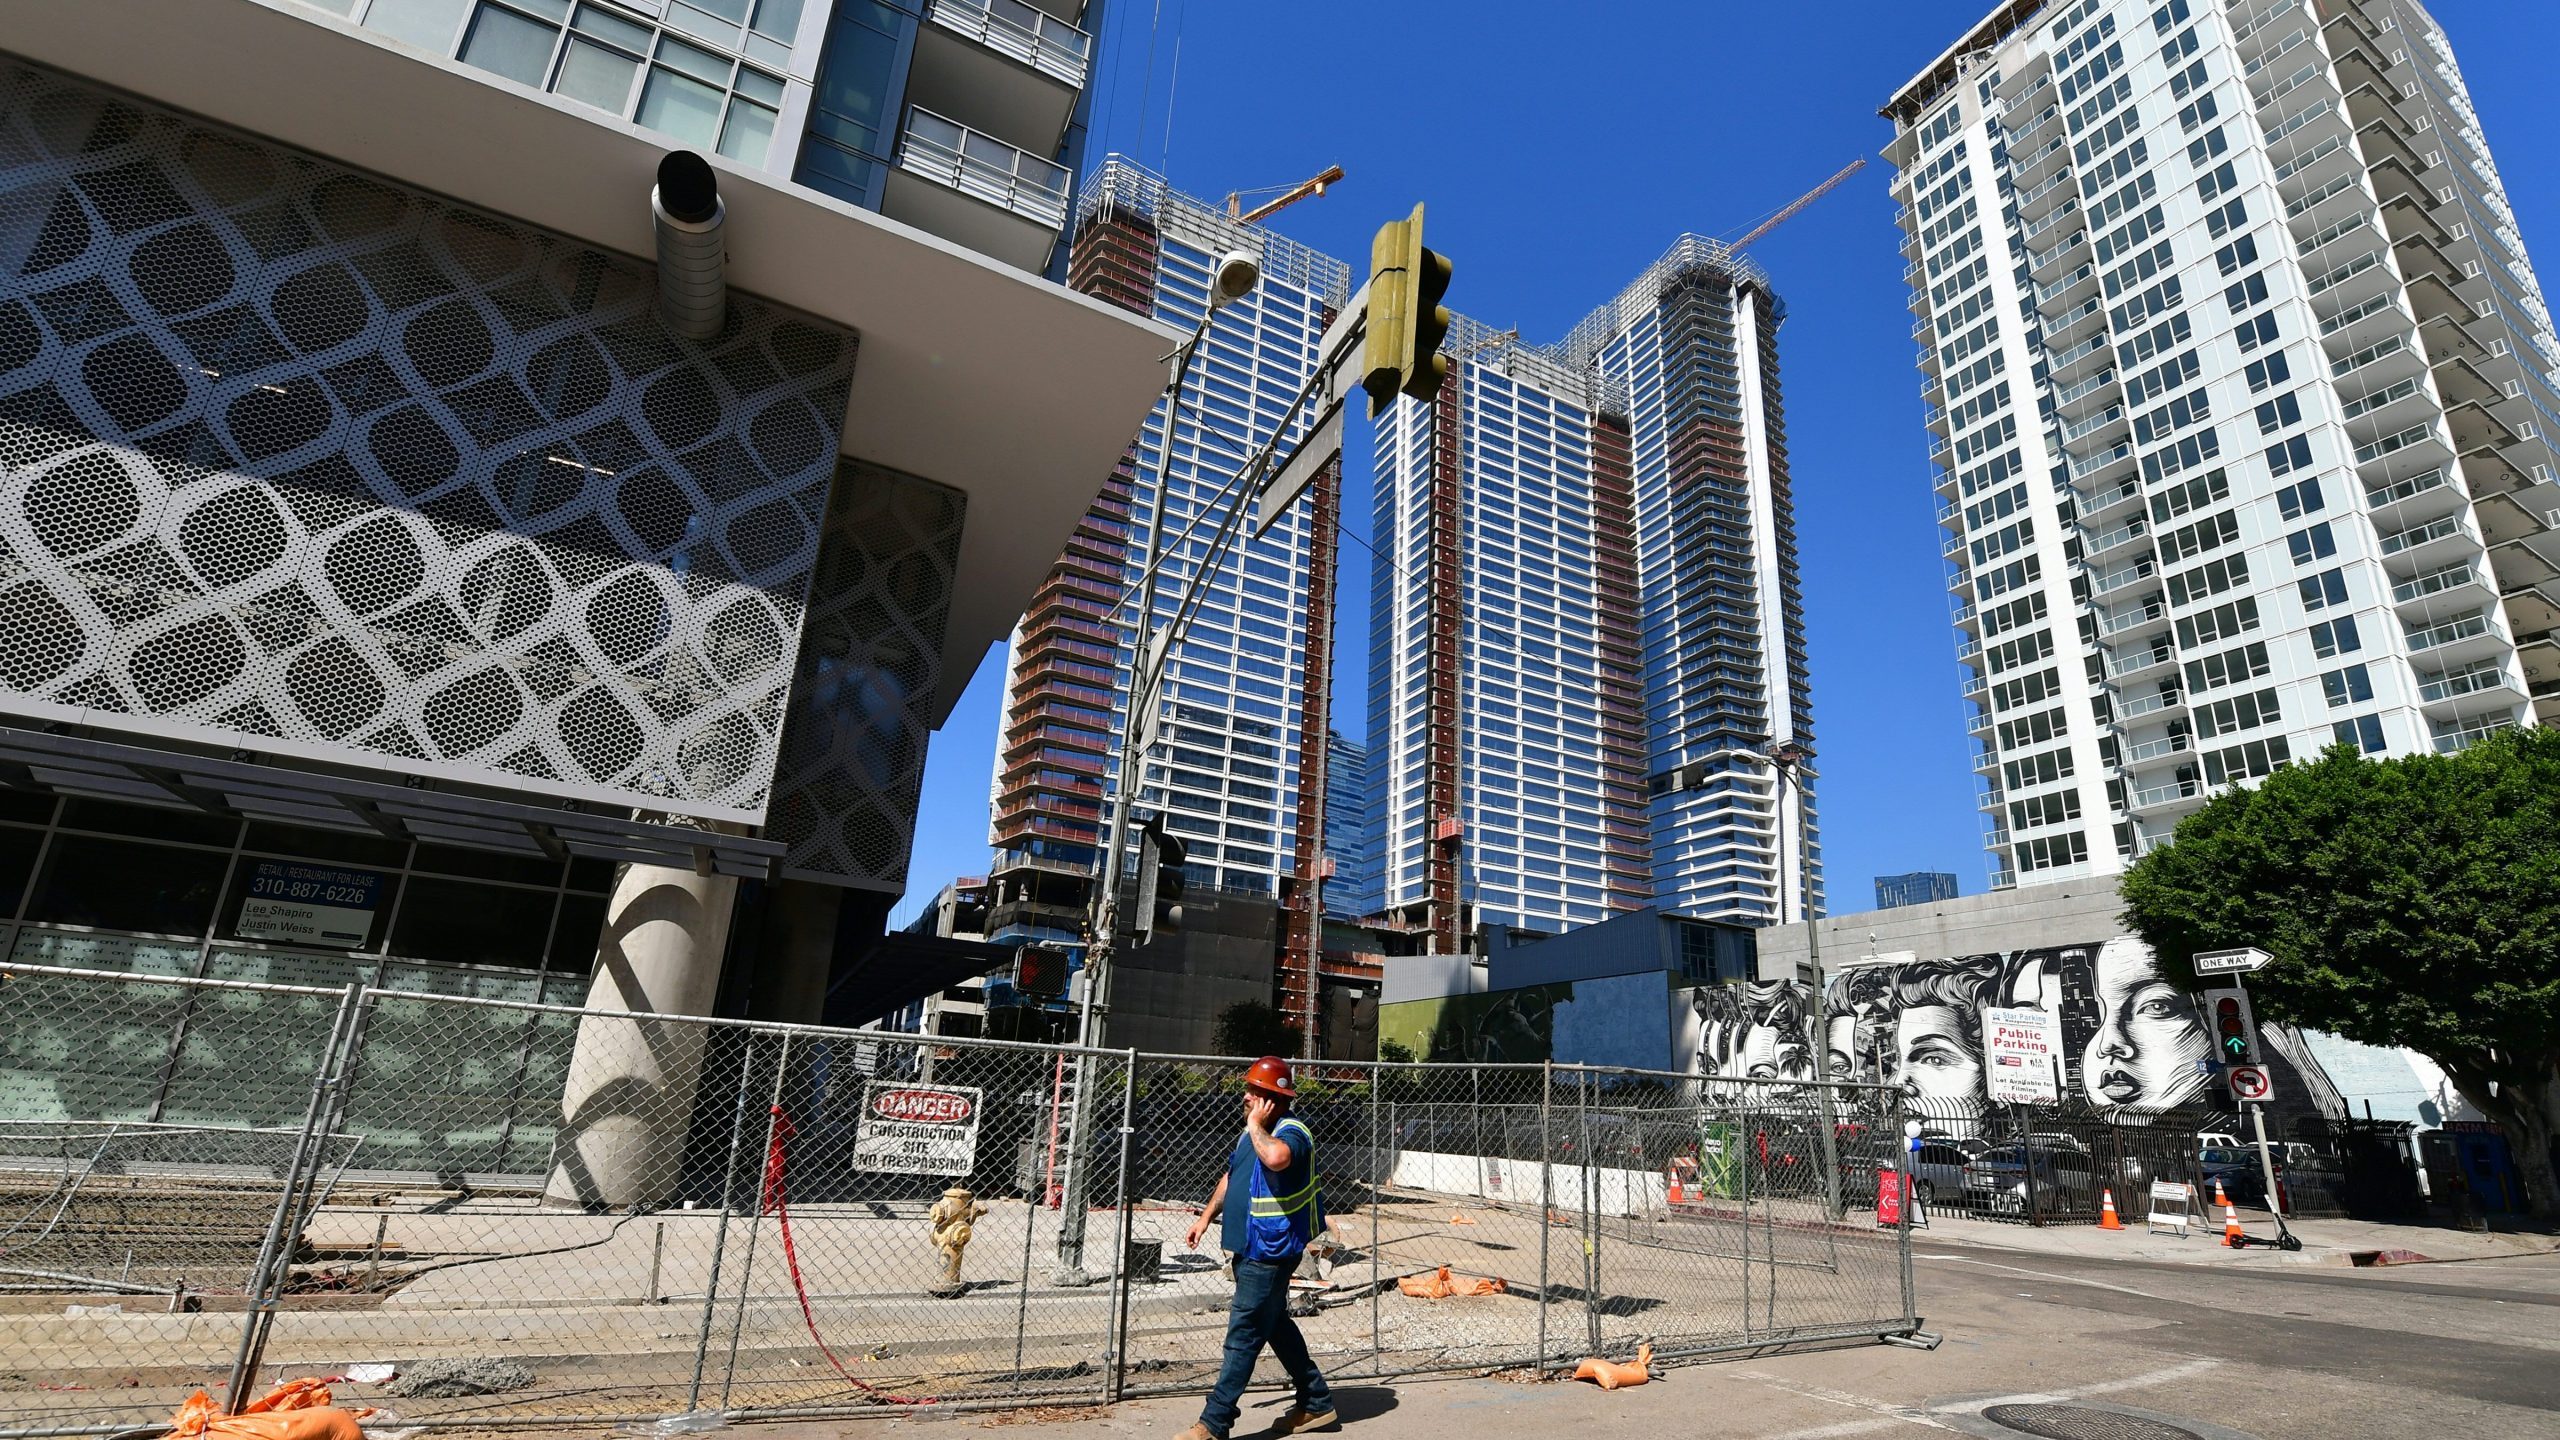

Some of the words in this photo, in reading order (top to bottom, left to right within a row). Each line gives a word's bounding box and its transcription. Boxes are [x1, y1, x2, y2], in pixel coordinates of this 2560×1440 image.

[258, 864, 284, 877] RETAIL
[288, 867, 337, 881] RESTAURANT
[337, 872, 351, 884] FOR
[351, 875, 375, 887] LEASE
[253, 877, 365, 904] 310-887-6226
[246, 903, 266, 914] Lee
[270, 906, 313, 919] Shapiro
[242, 919, 276, 931] Justin
[280, 922, 314, 935] Weiss
[2202, 958, 2223, 968] ONE
[2227, 956, 2248, 966] WAY
[2002, 1012, 2017, 1020] Star
[2020, 1014, 2047, 1025] Parking
[1998, 1027, 2042, 1040] Public
[1993, 1037, 2047, 1054] Parking
[2011, 1086, 2038, 1094] Filming
[879, 1094, 965, 1117] DANGER
[870, 1124, 966, 1141] CONSTRUCTION
[902, 1141, 930, 1154] SITE
[859, 1154, 877, 1167] NO
[882, 1155, 968, 1171] TRESPASSING
